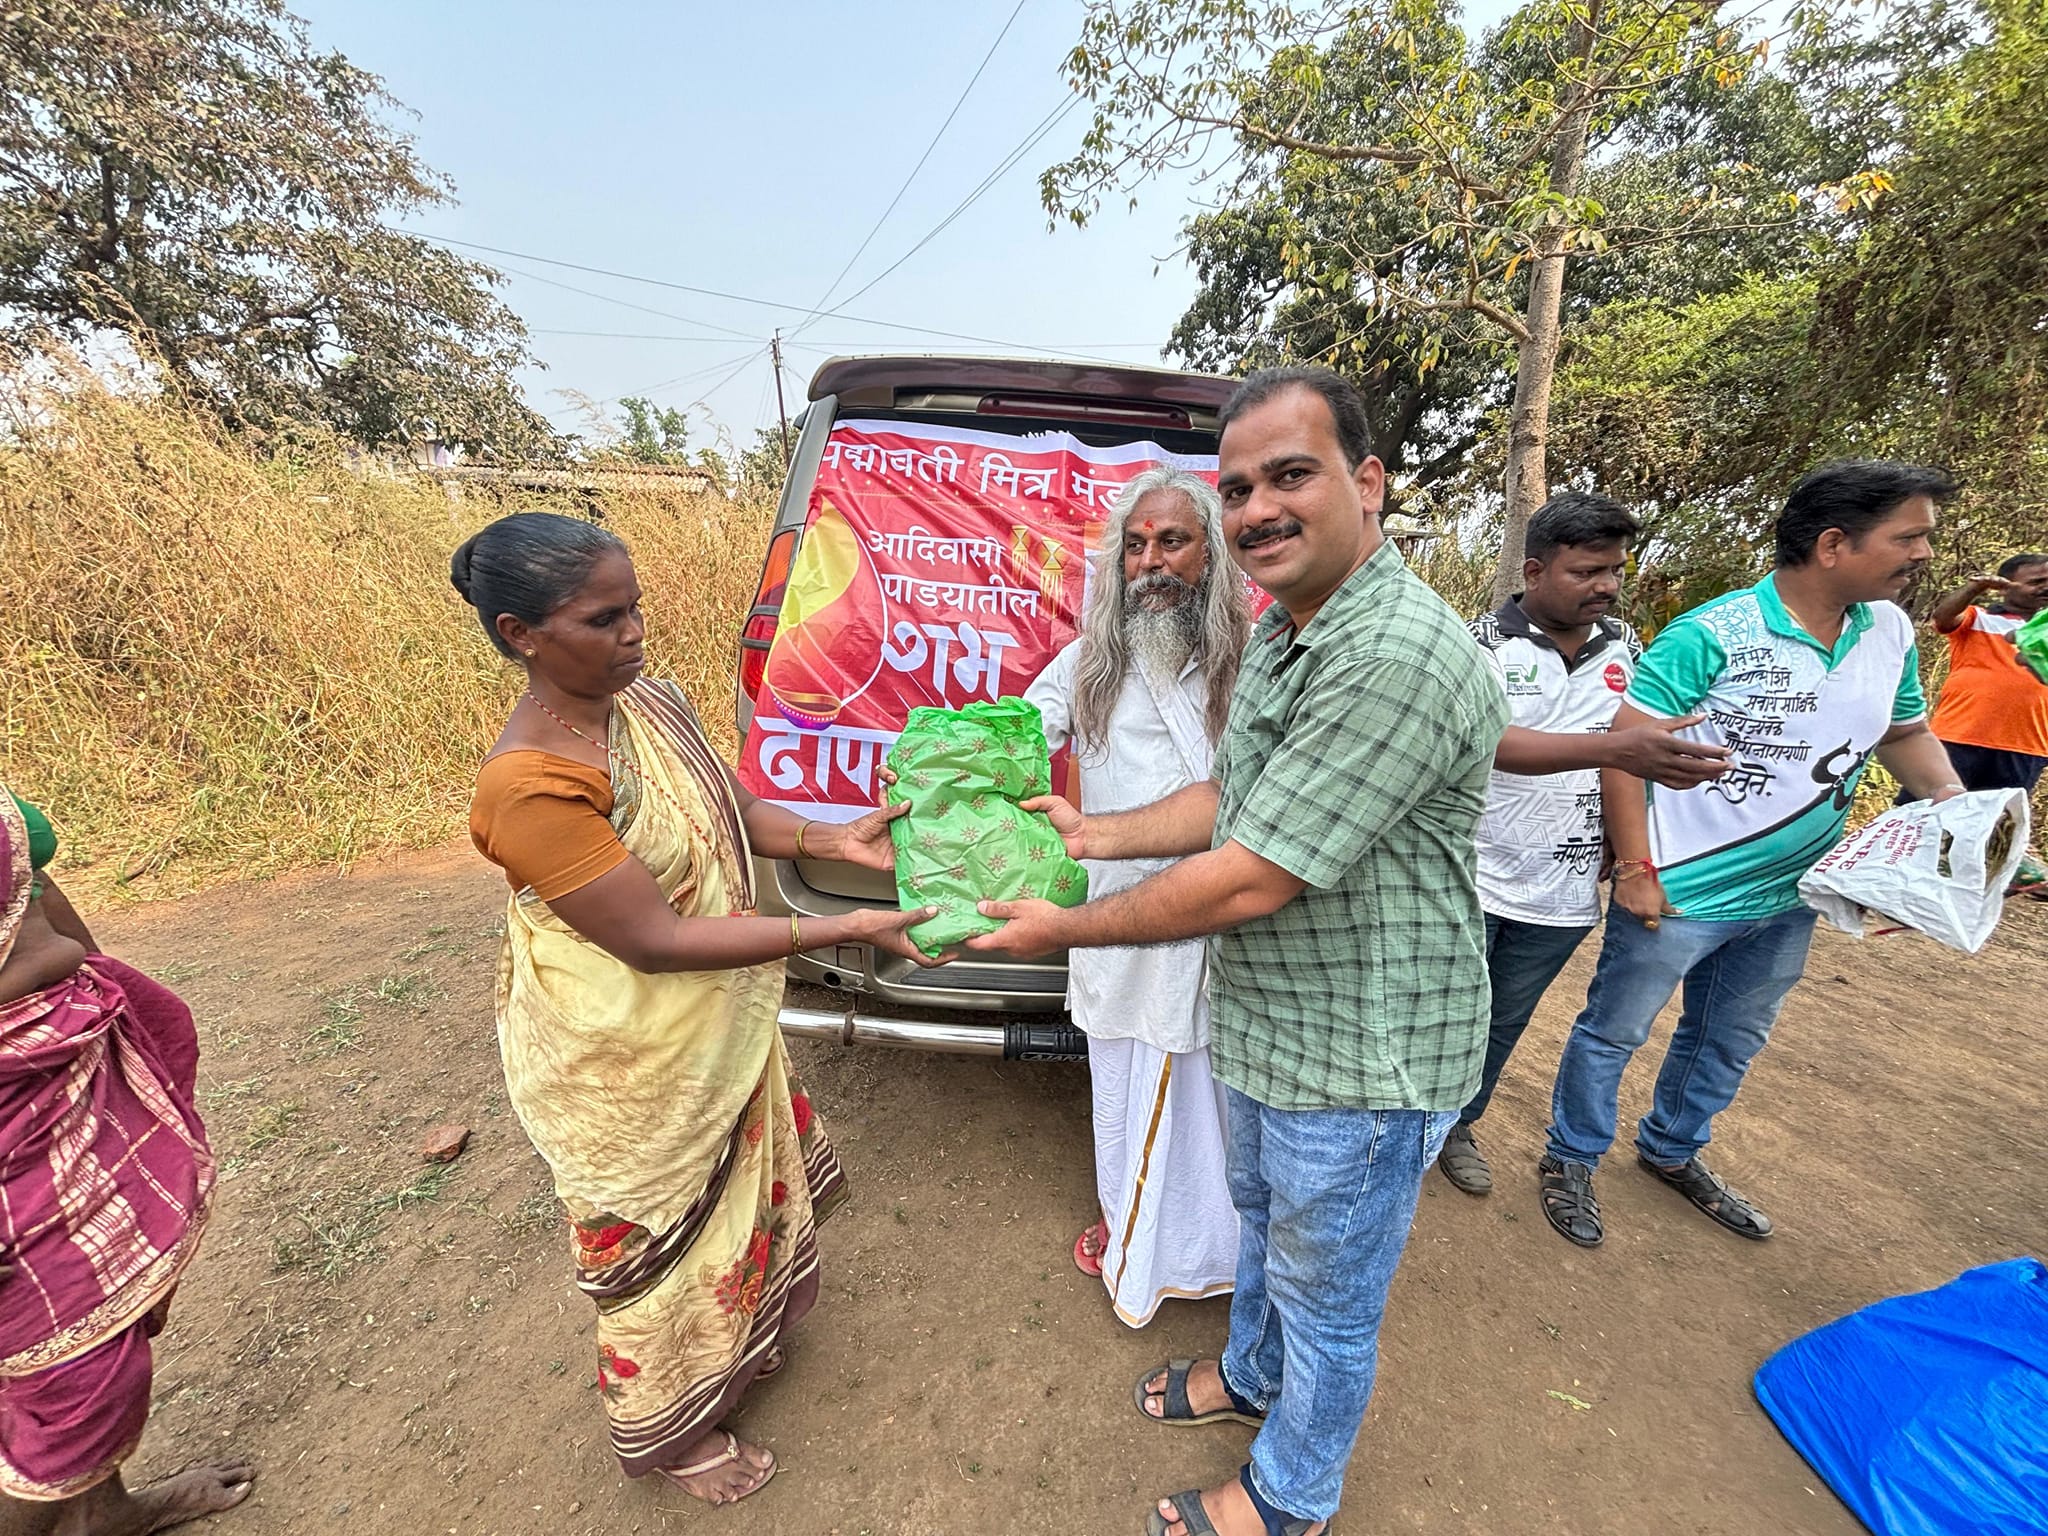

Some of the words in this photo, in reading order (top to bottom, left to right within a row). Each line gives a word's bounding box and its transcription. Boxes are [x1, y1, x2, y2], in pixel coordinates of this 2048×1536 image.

[979, 453, 1058, 499] मित्र
[1071, 468, 1131, 511] मंड
[867, 526, 1006, 568] आदिवासी
